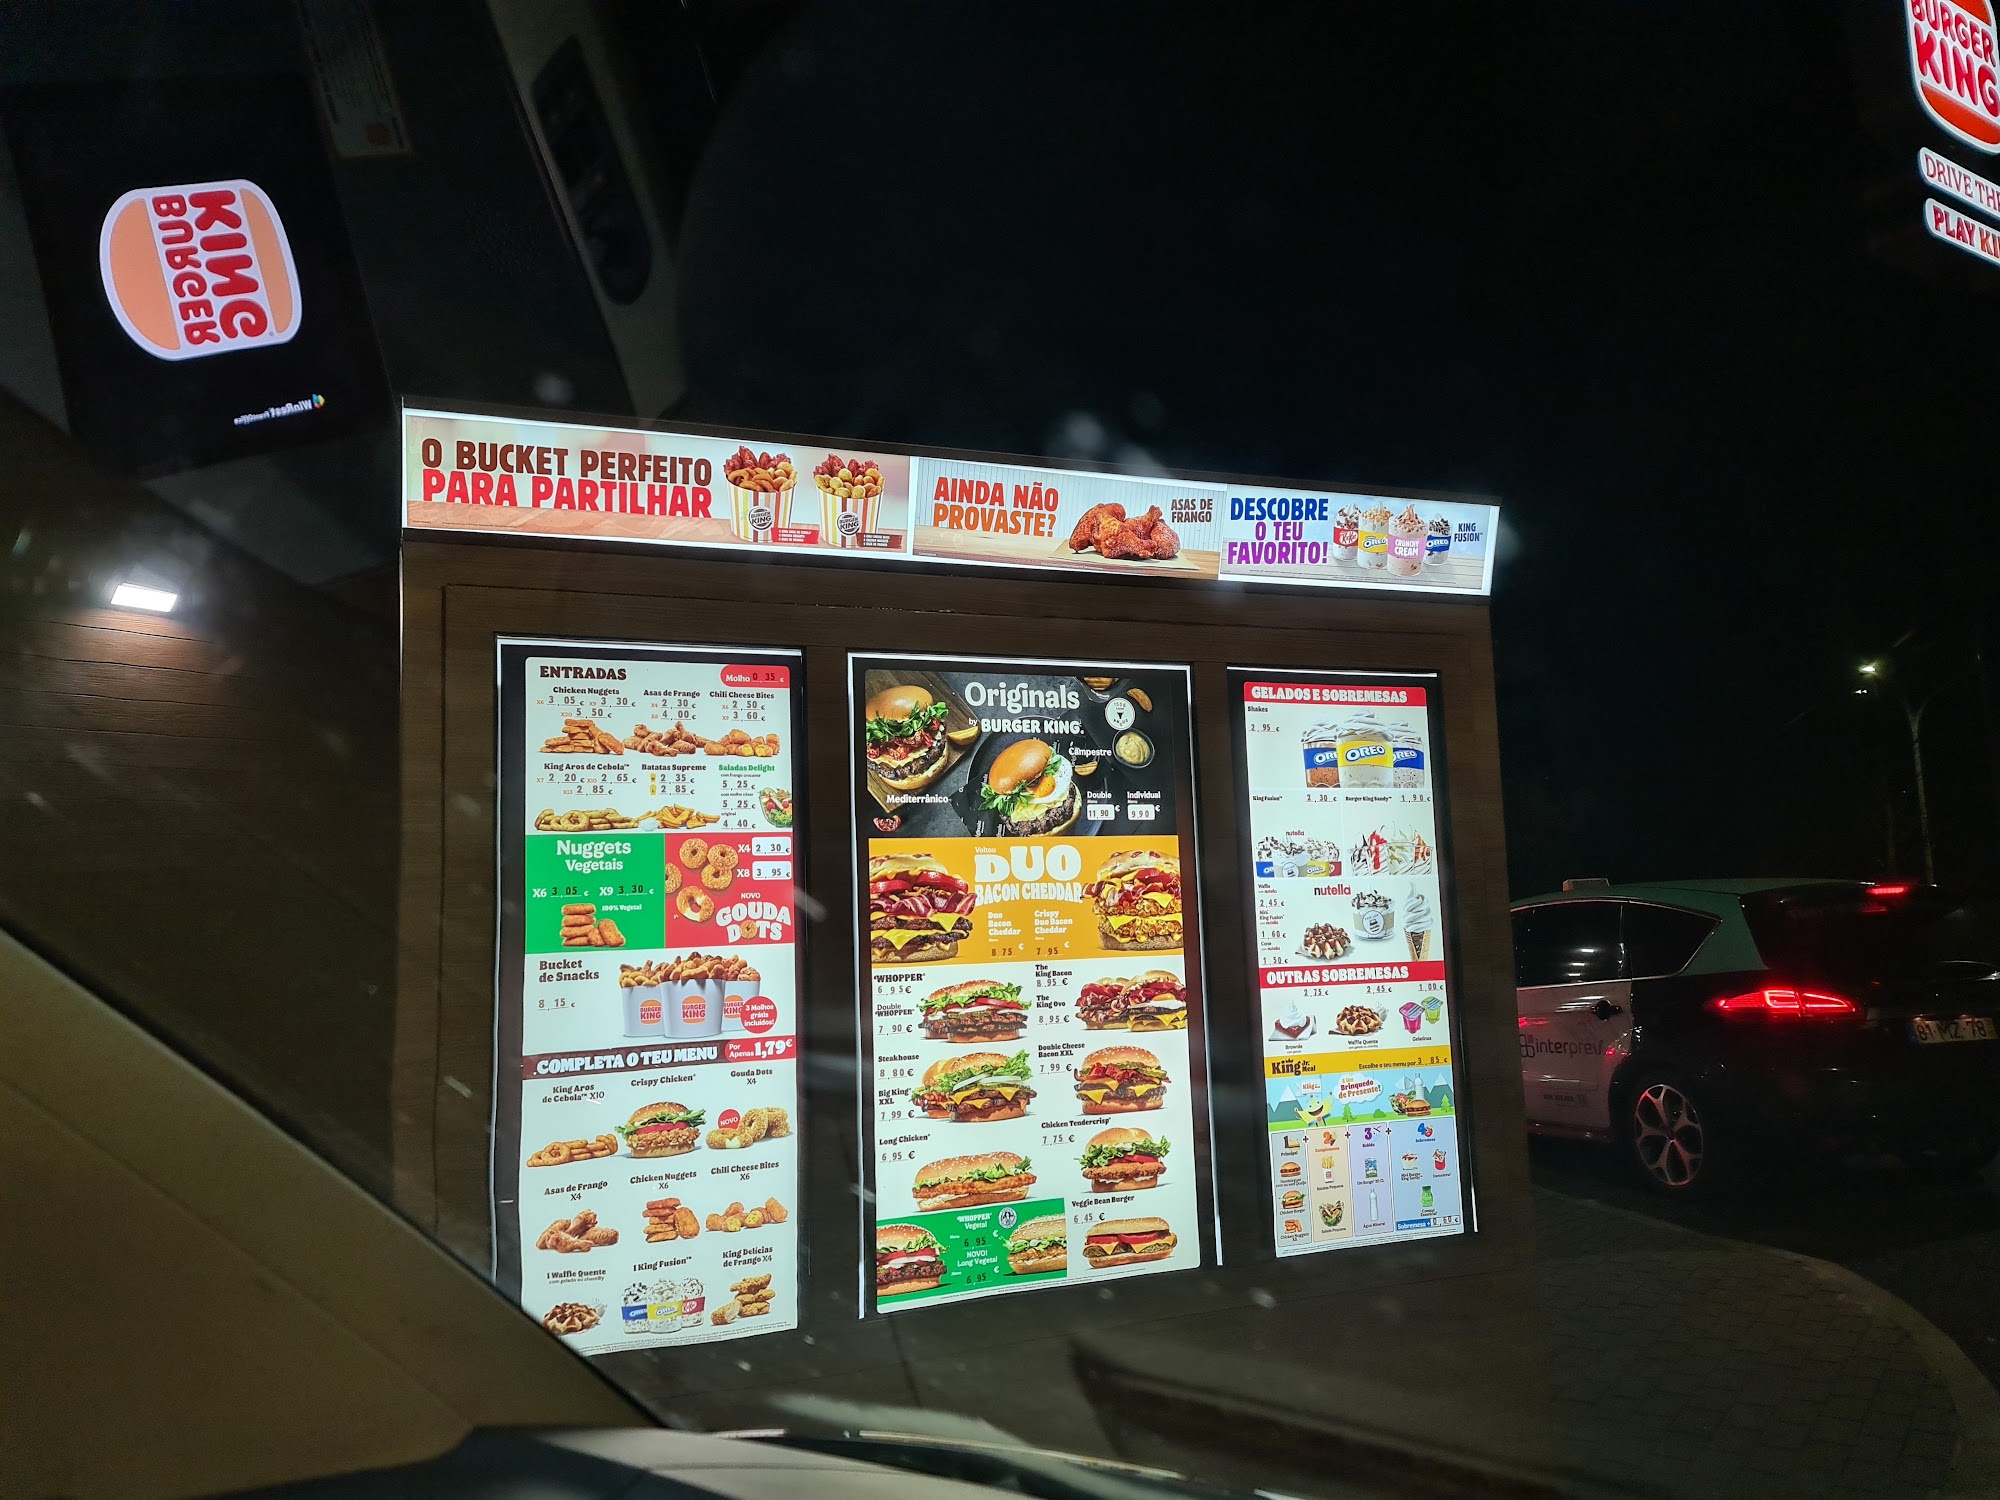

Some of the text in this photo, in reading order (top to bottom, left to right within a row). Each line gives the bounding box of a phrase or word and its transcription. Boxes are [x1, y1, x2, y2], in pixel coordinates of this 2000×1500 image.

[1914, 22, 2000, 117] KING
[1925, 153, 1973, 198] DRIVE
[1933, 205, 1976, 247] PLAY
[421, 438, 712, 487] O BUCKET PERFEITO
[423, 468, 712, 519] PARA PARTILHAR
[934, 476, 1059, 510] AINDA NÃO
[1171, 498, 1213, 512] ASAS DE
[1231, 497, 1329, 522] DESCOBRE
[933, 503, 1056, 538] PROVASTE?
[1172, 510, 1213, 524] FRANGO
[1255, 521, 1304, 541] O TEU
[1458, 523, 1476, 532] KING
[1395, 539, 1419, 548] CRUNCHY
[1227, 539, 1328, 566] FAVORITO!
[1395, 547, 1419, 556] CREAM
[540, 665, 627, 680] ENTRADAS
[725, 674, 750, 683] Molho
[553, 687, 620, 696] Chicken Nuggets
[672, 690, 700, 698] Frango
[710, 691, 727, 699] Chili
[1251, 687, 1407, 703] GELADOS SOBREMESAS
[965, 682, 1080, 714] Originals
[968, 717, 1041, 734] by BURGER
[1346, 746, 1385, 761] OREO
[544, 763, 564, 771] King
[672, 764, 707, 772] Supreme
[748, 764, 775, 773] Delight
[886, 794, 949, 804] Mediterrânico
[1087, 791, 1112, 799] Double
[1127, 791, 1160, 799] Individual
[556, 839, 632, 857] Nuggets
[738, 844, 750, 853] X4
[975, 846, 996, 854] Voltou
[565, 859, 623, 874] Vegetais
[974, 845, 1081, 882] DUO
[736, 869, 750, 878] X8
[532, 888, 547, 898] X6
[599, 886, 613, 896] X9
[975, 883, 1083, 907] BACON CHEDDAR
[1314, 884, 1351, 896] nutella
[715, 902, 791, 927] GOUDA
[988, 911, 1003, 919] Duo
[1034, 910, 1059, 919] Crispy
[1035, 918, 1049, 926] Duo
[988, 927, 1021, 936] Cheddar
[1035, 926, 1067, 935] Cheddar
[539, 959, 583, 971] Bucket
[539, 970, 600, 982] de Snacks
[1267, 966, 1409, 985] OUTRAS SOBREMESAS
[682, 1003, 706, 1011] BURGER
[1037, 1001, 1052, 1009] King
[641, 1011, 661, 1019] KING
[682, 1008, 706, 1018] KING
[750, 1011, 769, 1020] grátis
[1038, 1043, 1061, 1051] Double
[729, 1049, 754, 1059] Apenas
[878, 1054, 919, 1062] Steakhouse
[537, 1047, 718, 1074] COMPLETA O TEU MENU
[1272, 1059, 1301, 1076] King
[730, 1068, 773, 1078] Gouda Dots
[631, 1077, 658, 1087] Crispy
[1341, 1080, 1373, 1091] Brinquedo
[553, 1083, 594, 1095] King Aros
[879, 1090, 891, 1098] Big
[1348, 1085, 1381, 1097] Presente!
[720, 1116, 739, 1127] NOVO
[711, 1161, 779, 1175] Chili Cheese Bites
[630, 1170, 697, 1184] Chicken Nuggets
[544, 1180, 608, 1196] Asas de Frango
[1072, 1194, 1135, 1208] Veggie Bean Burger
[964, 1221, 987, 1230] Vegetal
[1397, 1222, 1426, 1230] Sobremesa
[723, 1246, 773, 1260] King Delícias
[967, 1250, 987, 1258] NOVO!
[734, 1256, 761, 1267] Frango
[975, 1256, 998, 1265] Vegetal
[638, 1261, 658, 1272] King
[551, 1269, 606, 1279] Waffle Quente
